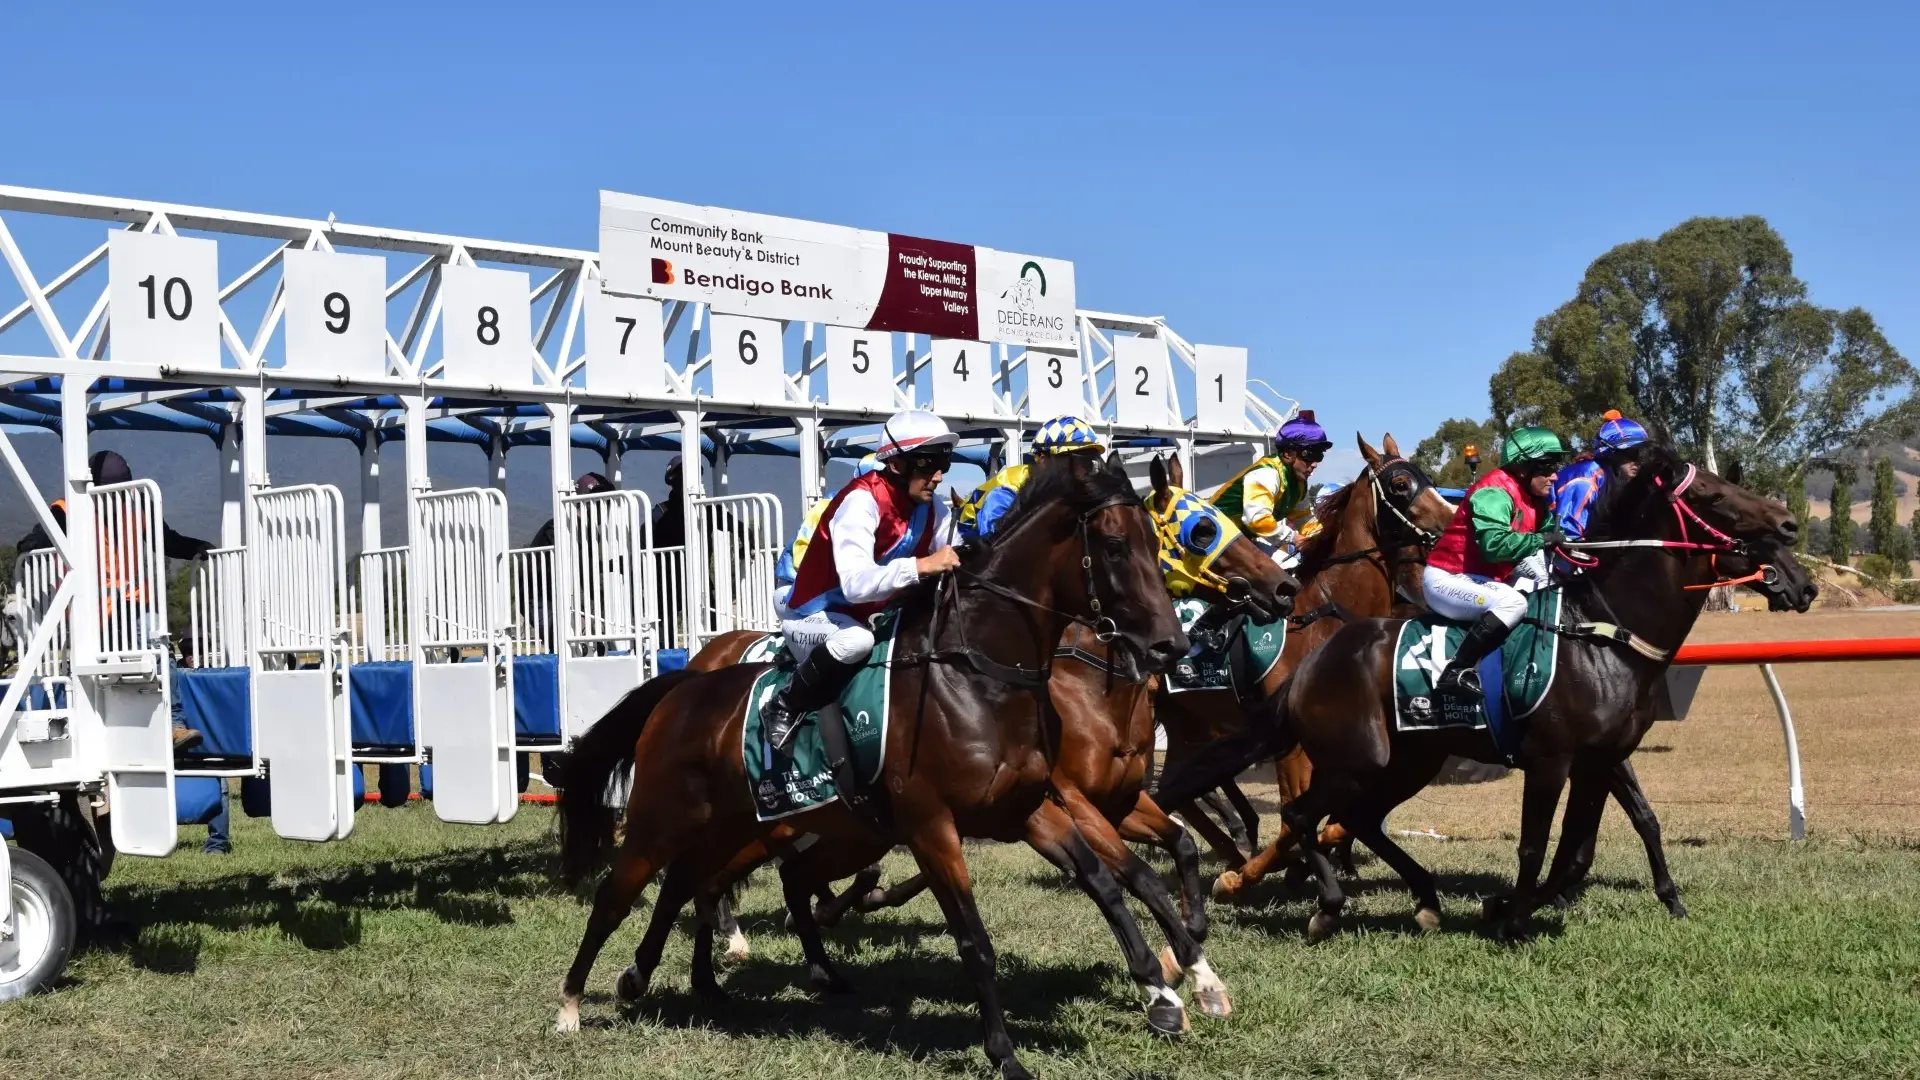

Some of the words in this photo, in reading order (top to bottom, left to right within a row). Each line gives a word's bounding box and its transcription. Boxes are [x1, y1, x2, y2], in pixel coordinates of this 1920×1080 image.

[651, 218, 728, 242] Community
[732, 229, 763, 245] Bank
[651, 237, 693, 254] Mount
[697, 243, 741, 262] Beauty
[745, 249, 753, 260] &
[758, 250, 800, 266] District
[899, 253, 927, 268] Proudly
[929, 257, 967, 275] Supporting
[684, 268, 775, 296] Bendigo
[781, 280, 833, 300] Bank
[904, 268, 917, 279] the
[918, 270, 942, 284] Kiewa,
[943, 274, 960, 286] Mitta
[961, 277, 967, 286] &
[139, 275, 193, 321] 10
[921, 284, 942, 298] Upper
[943, 287, 968, 302] Murray
[943, 301, 969, 315] Valleys
[324, 292, 351, 335] 9
[477, 306, 500, 346] 8
[998, 310, 1064, 331] DEDERANG
[615, 316, 637, 355] 7
[738, 329, 758, 365] 6
[853, 339, 870, 374] 5
[953, 349, 970, 382] 4
[1047, 357, 1063, 389] 3
[1135, 365, 1149, 396] 2
[1214, 374, 1223, 403] 1
[1447, 588, 1479, 604] WALKER
[1402, 625, 1453, 690] 4
[781, 770, 800, 781] THE
